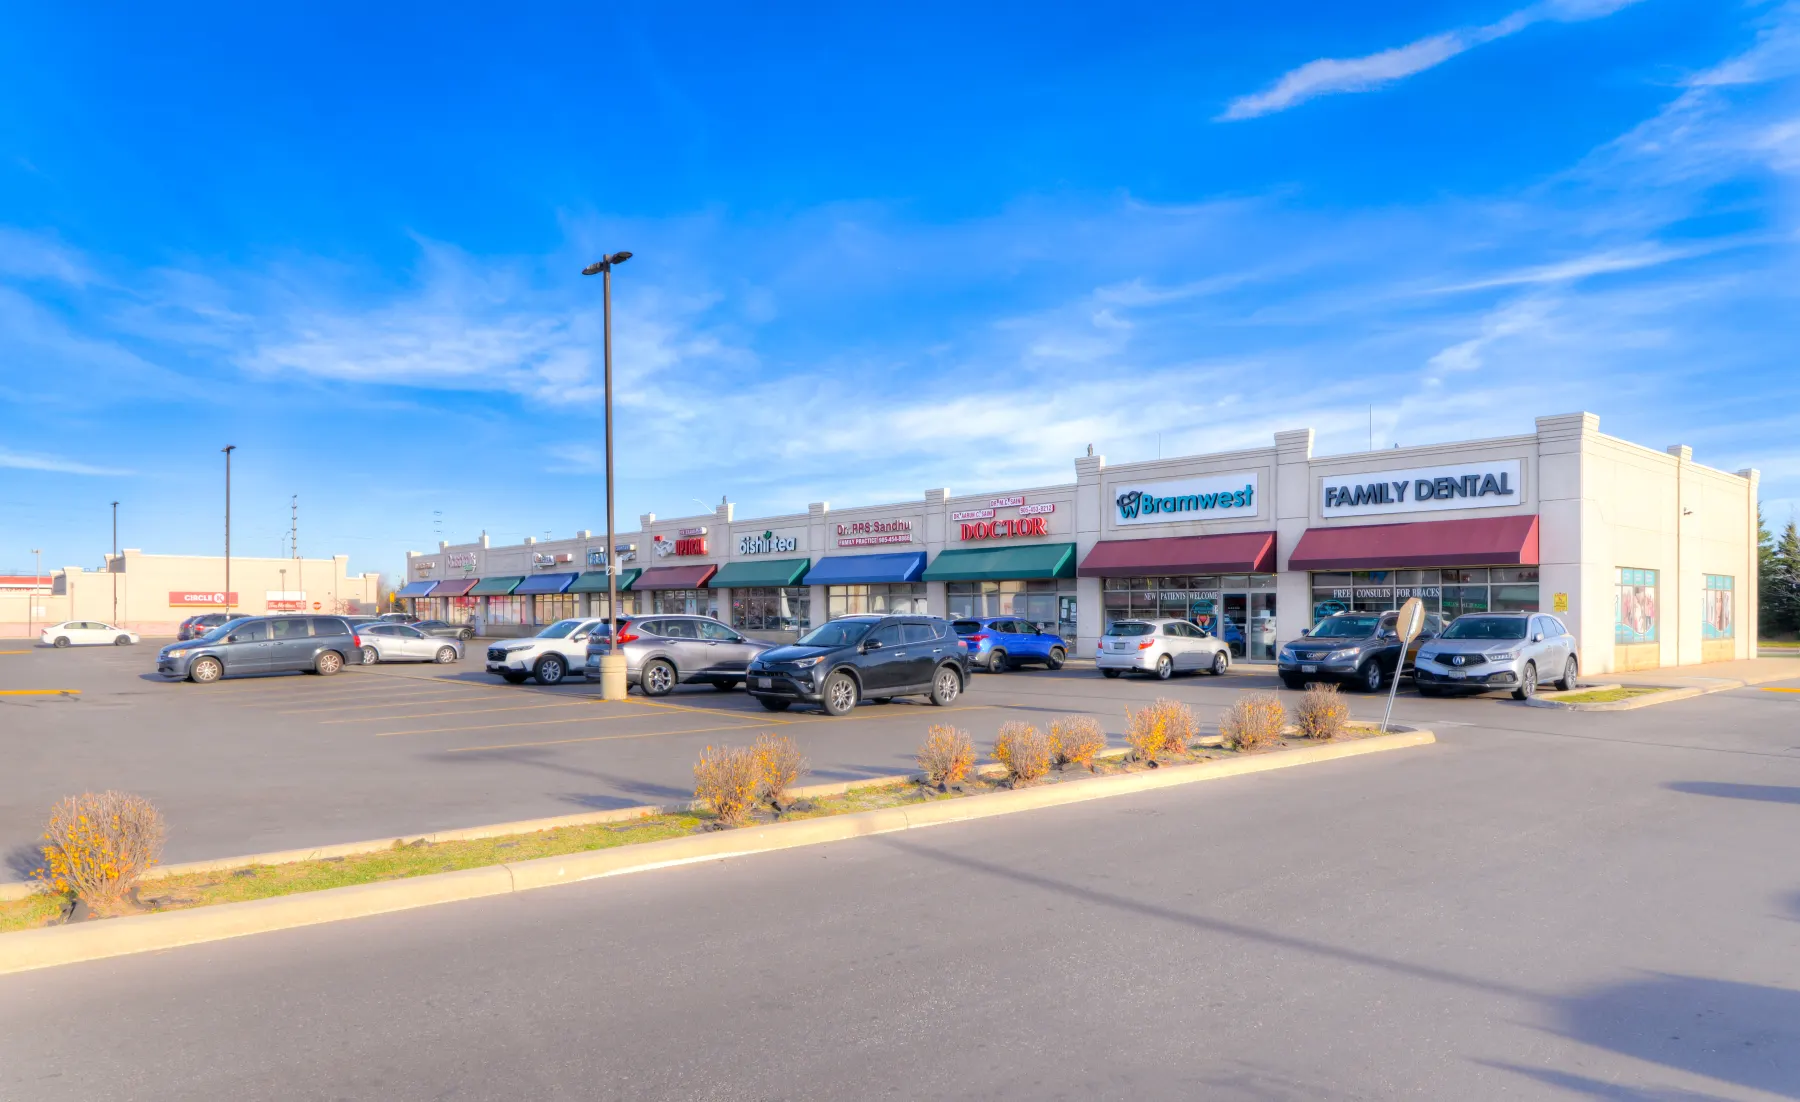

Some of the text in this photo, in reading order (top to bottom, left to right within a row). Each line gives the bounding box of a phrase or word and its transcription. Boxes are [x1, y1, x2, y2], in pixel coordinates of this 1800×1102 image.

[1325, 472, 1514, 508] FAMILY DENTAL
[1142, 484, 1254, 515] Bramwest
[837, 524, 851, 536] Dr.
[873, 519, 912, 533] Sandhu
[960, 517, 1048, 541] DOCTOR
[773, 536, 797, 552] tea
[838, 538, 855, 546] FAMILY
[855, 536, 877, 545] PRACTICE
[184, 594, 213, 602] CIRCLE
[1144, 591, 1218, 601] NEW PATIENTS WELCOME
[1333, 587, 1440, 598] FREE CONSULTS FOR BRACES
